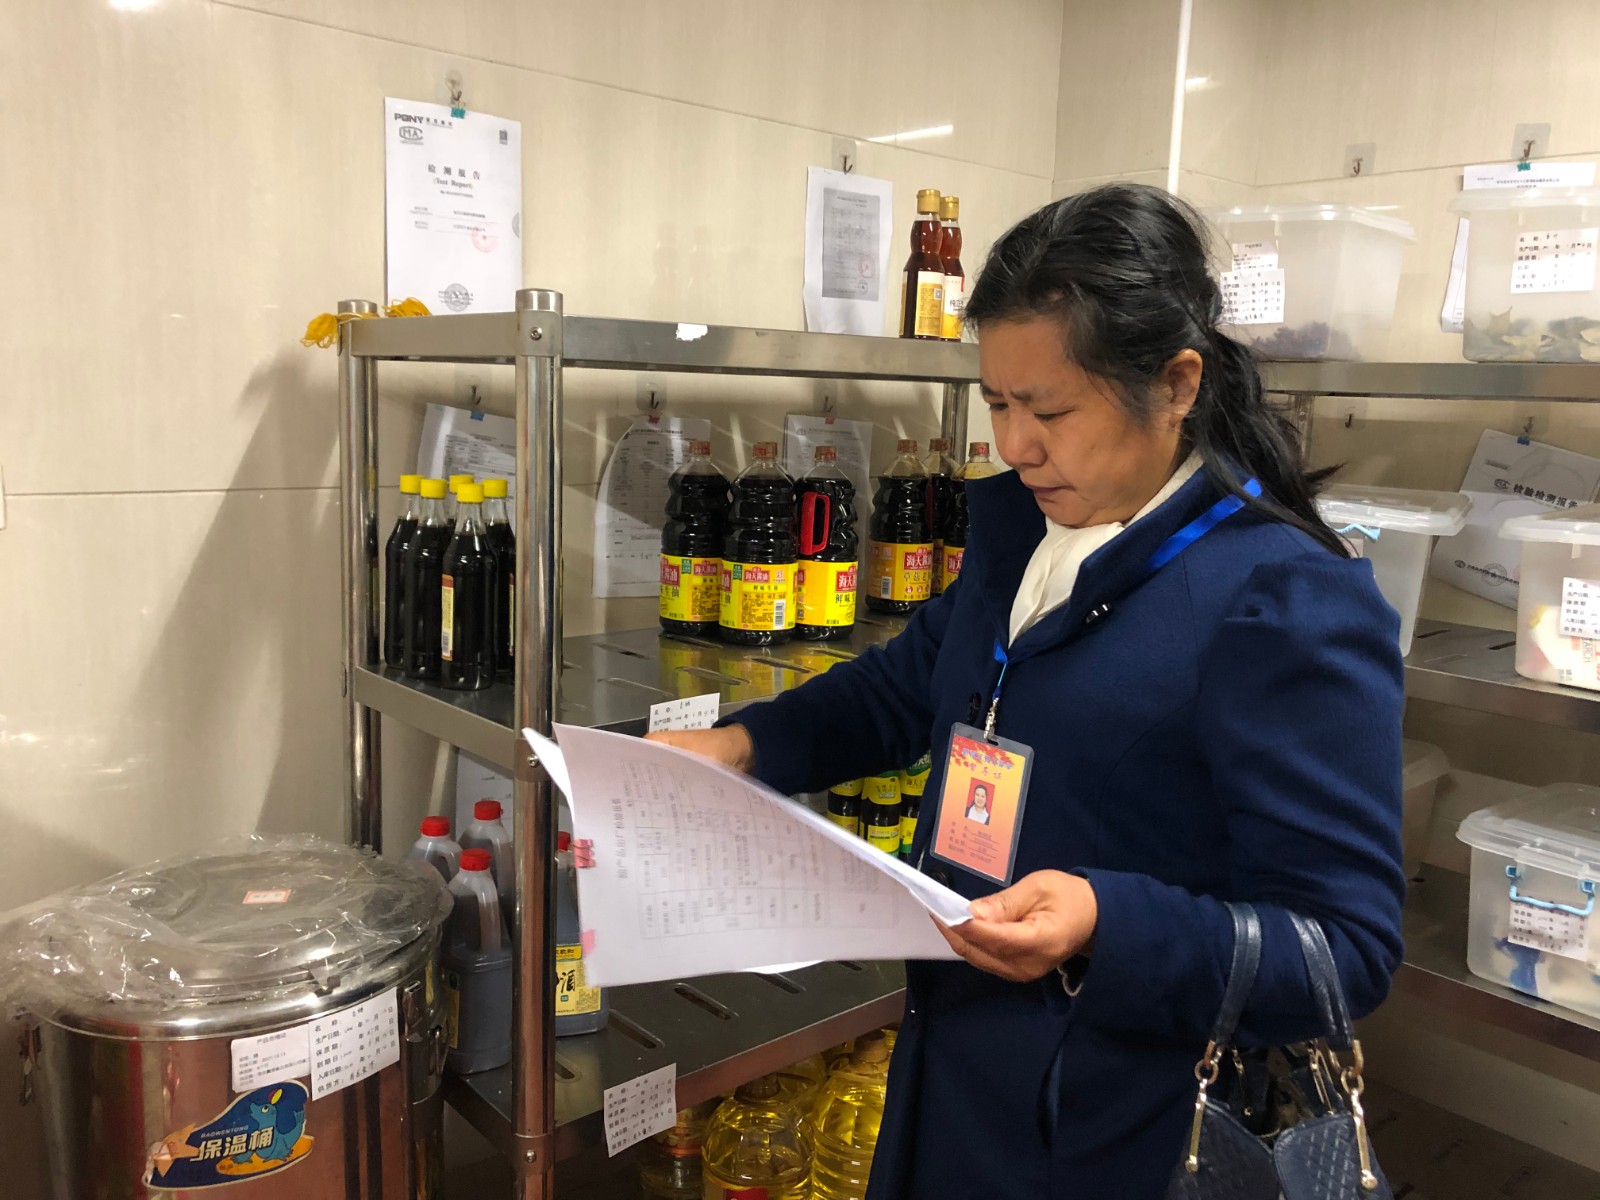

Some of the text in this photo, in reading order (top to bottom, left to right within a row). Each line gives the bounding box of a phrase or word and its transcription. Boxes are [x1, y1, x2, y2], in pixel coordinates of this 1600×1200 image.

[393, 112, 424, 124] PONY
[428, 163, 480, 180] 检测报告
[200, 1125, 249, 1138] BAOWENTONG
[190, 1126, 274, 1162] 保温桶
